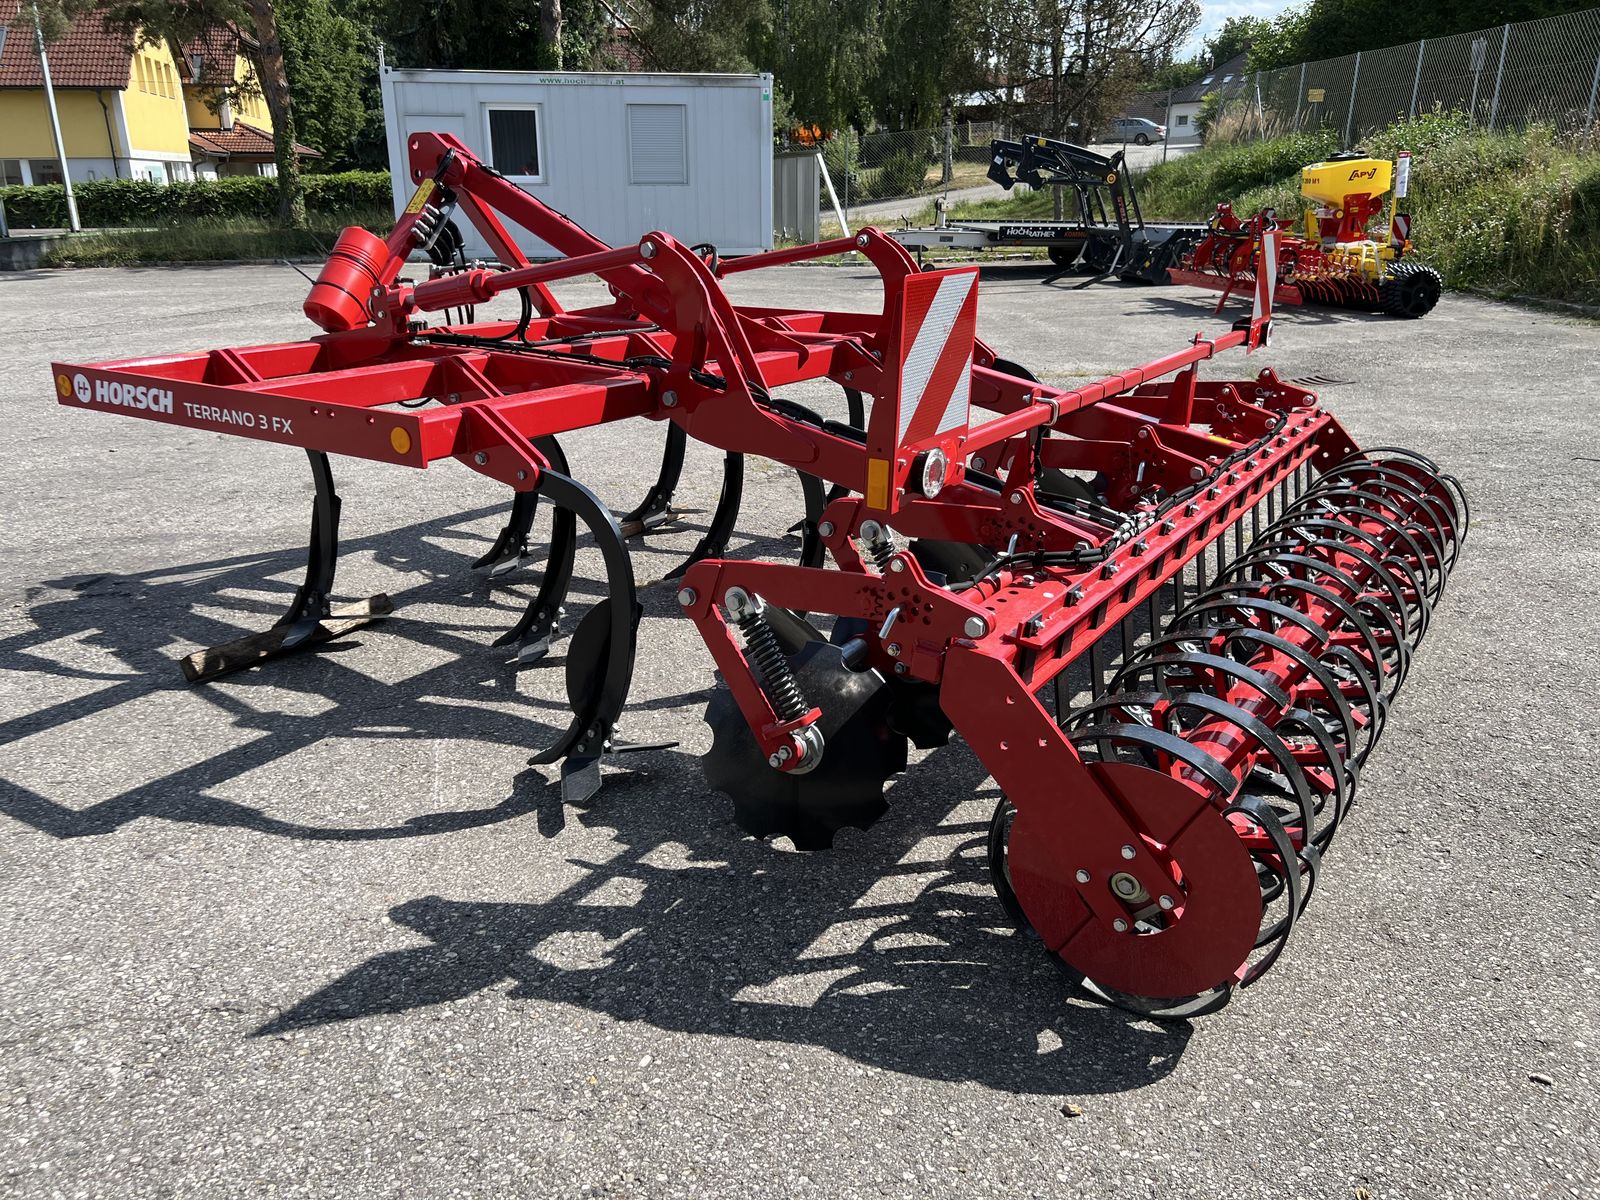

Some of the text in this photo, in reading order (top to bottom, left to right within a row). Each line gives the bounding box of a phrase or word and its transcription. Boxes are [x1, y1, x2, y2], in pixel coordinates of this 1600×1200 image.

[95, 380, 294, 435] HORSCH TERRANO 3 FX
